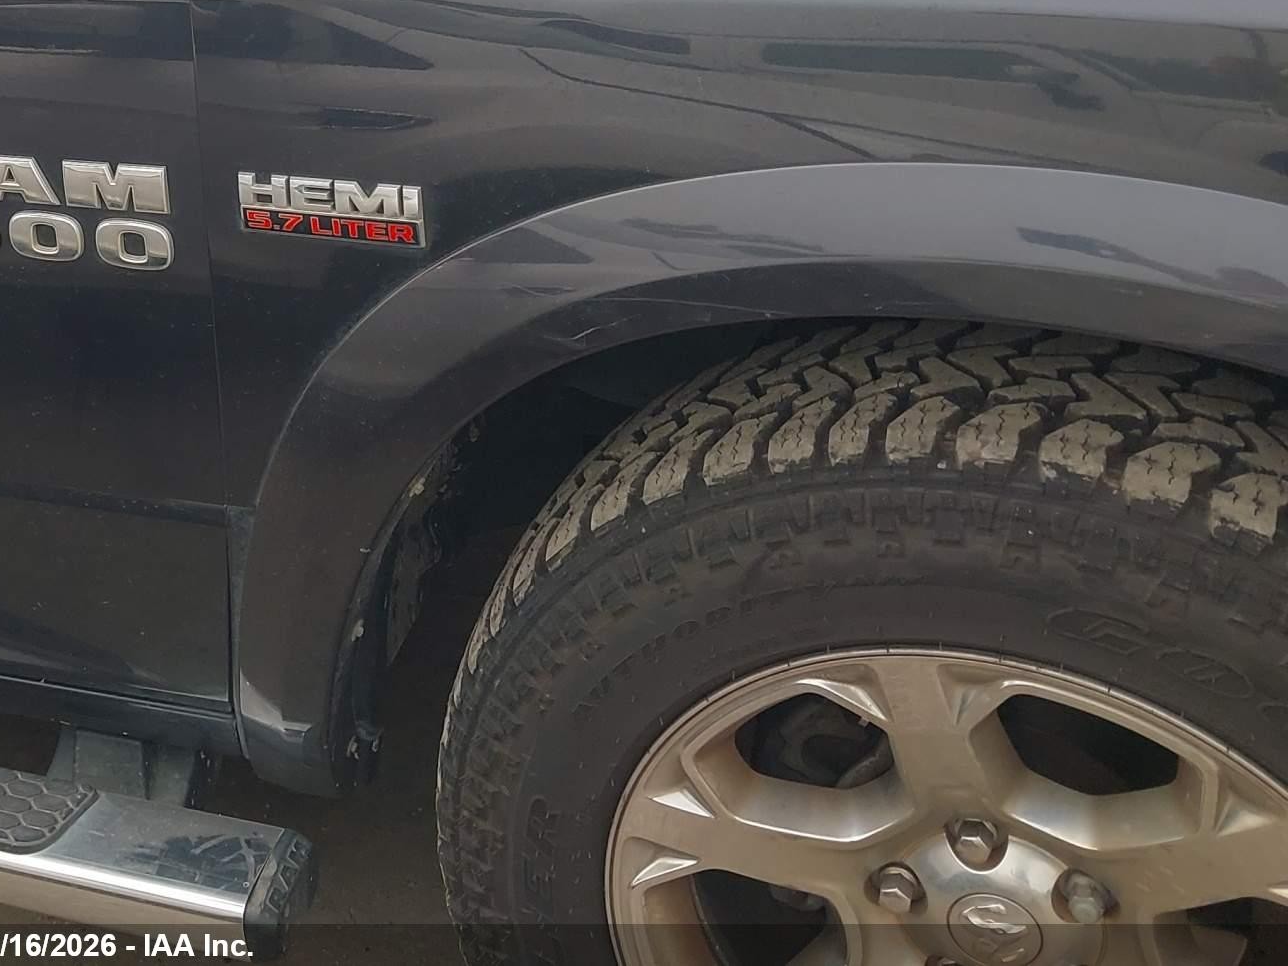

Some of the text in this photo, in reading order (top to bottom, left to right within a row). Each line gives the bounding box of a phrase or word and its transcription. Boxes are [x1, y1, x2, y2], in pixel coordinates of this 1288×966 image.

[238, 171, 423, 221] HEMI
[246, 209, 416, 244] 5.7 LITER
